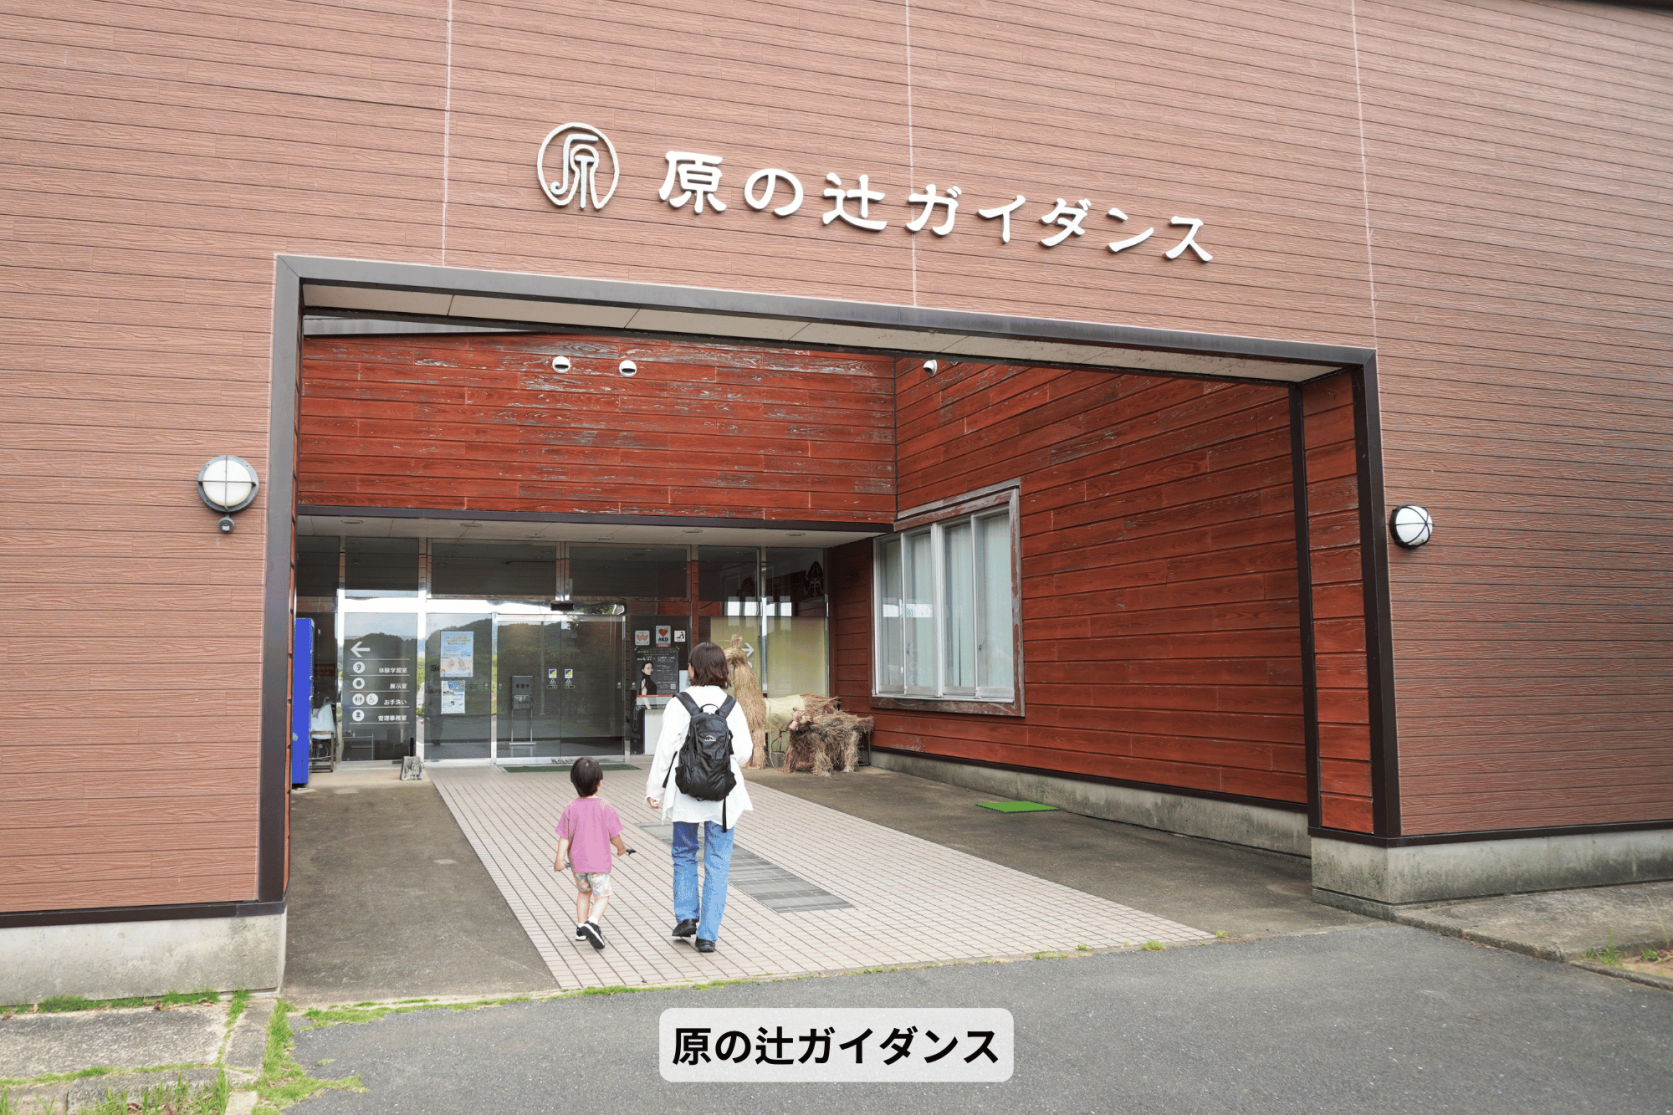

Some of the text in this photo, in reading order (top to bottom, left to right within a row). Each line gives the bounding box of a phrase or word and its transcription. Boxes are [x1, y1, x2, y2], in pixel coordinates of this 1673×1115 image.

[658, 150, 1213, 263] 原の辻ガイダンス
